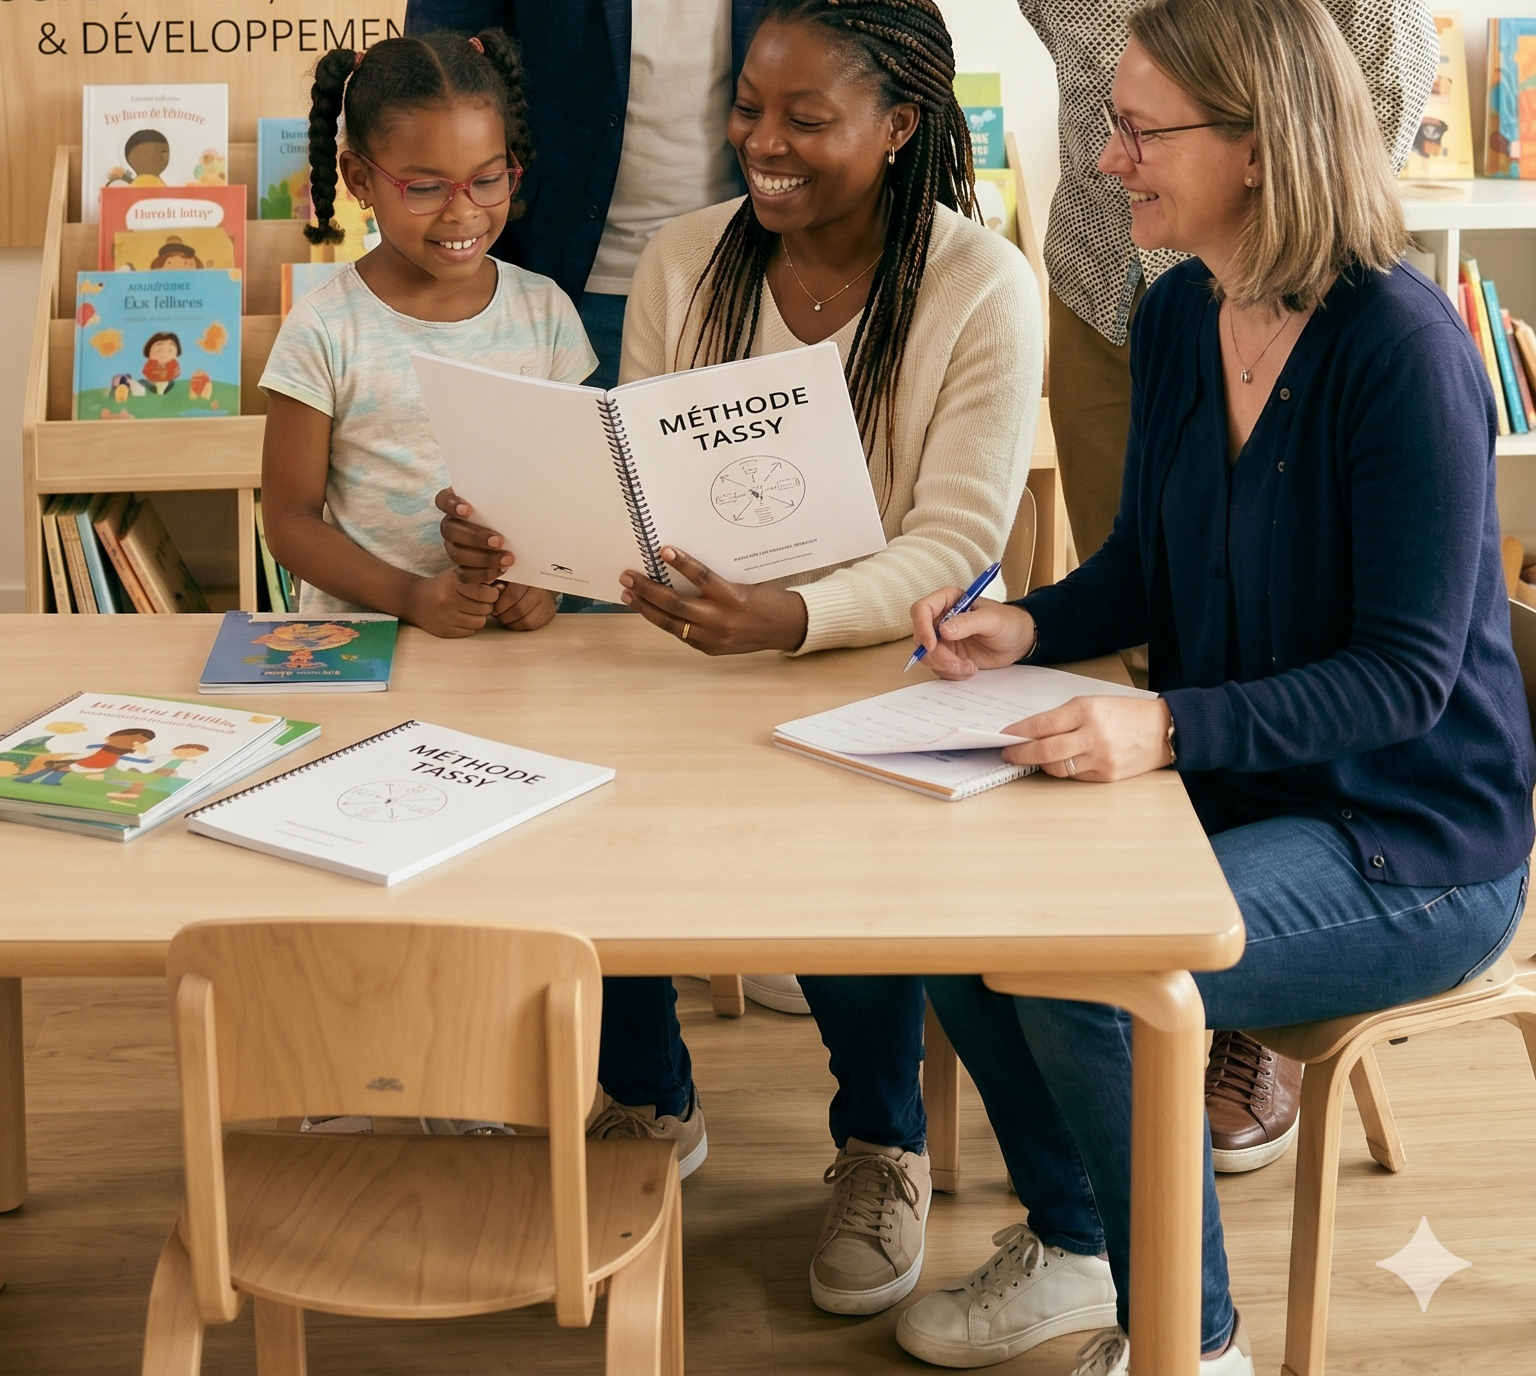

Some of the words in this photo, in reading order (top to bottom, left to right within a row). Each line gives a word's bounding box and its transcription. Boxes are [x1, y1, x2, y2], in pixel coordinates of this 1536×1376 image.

[38, 22, 68, 55] &
[659, 387, 809, 436] MÉTHODE
[693, 416, 783, 452] TASSY
[409, 744, 546, 785] MÉTHODE
[411, 761, 497, 788] TASSY
